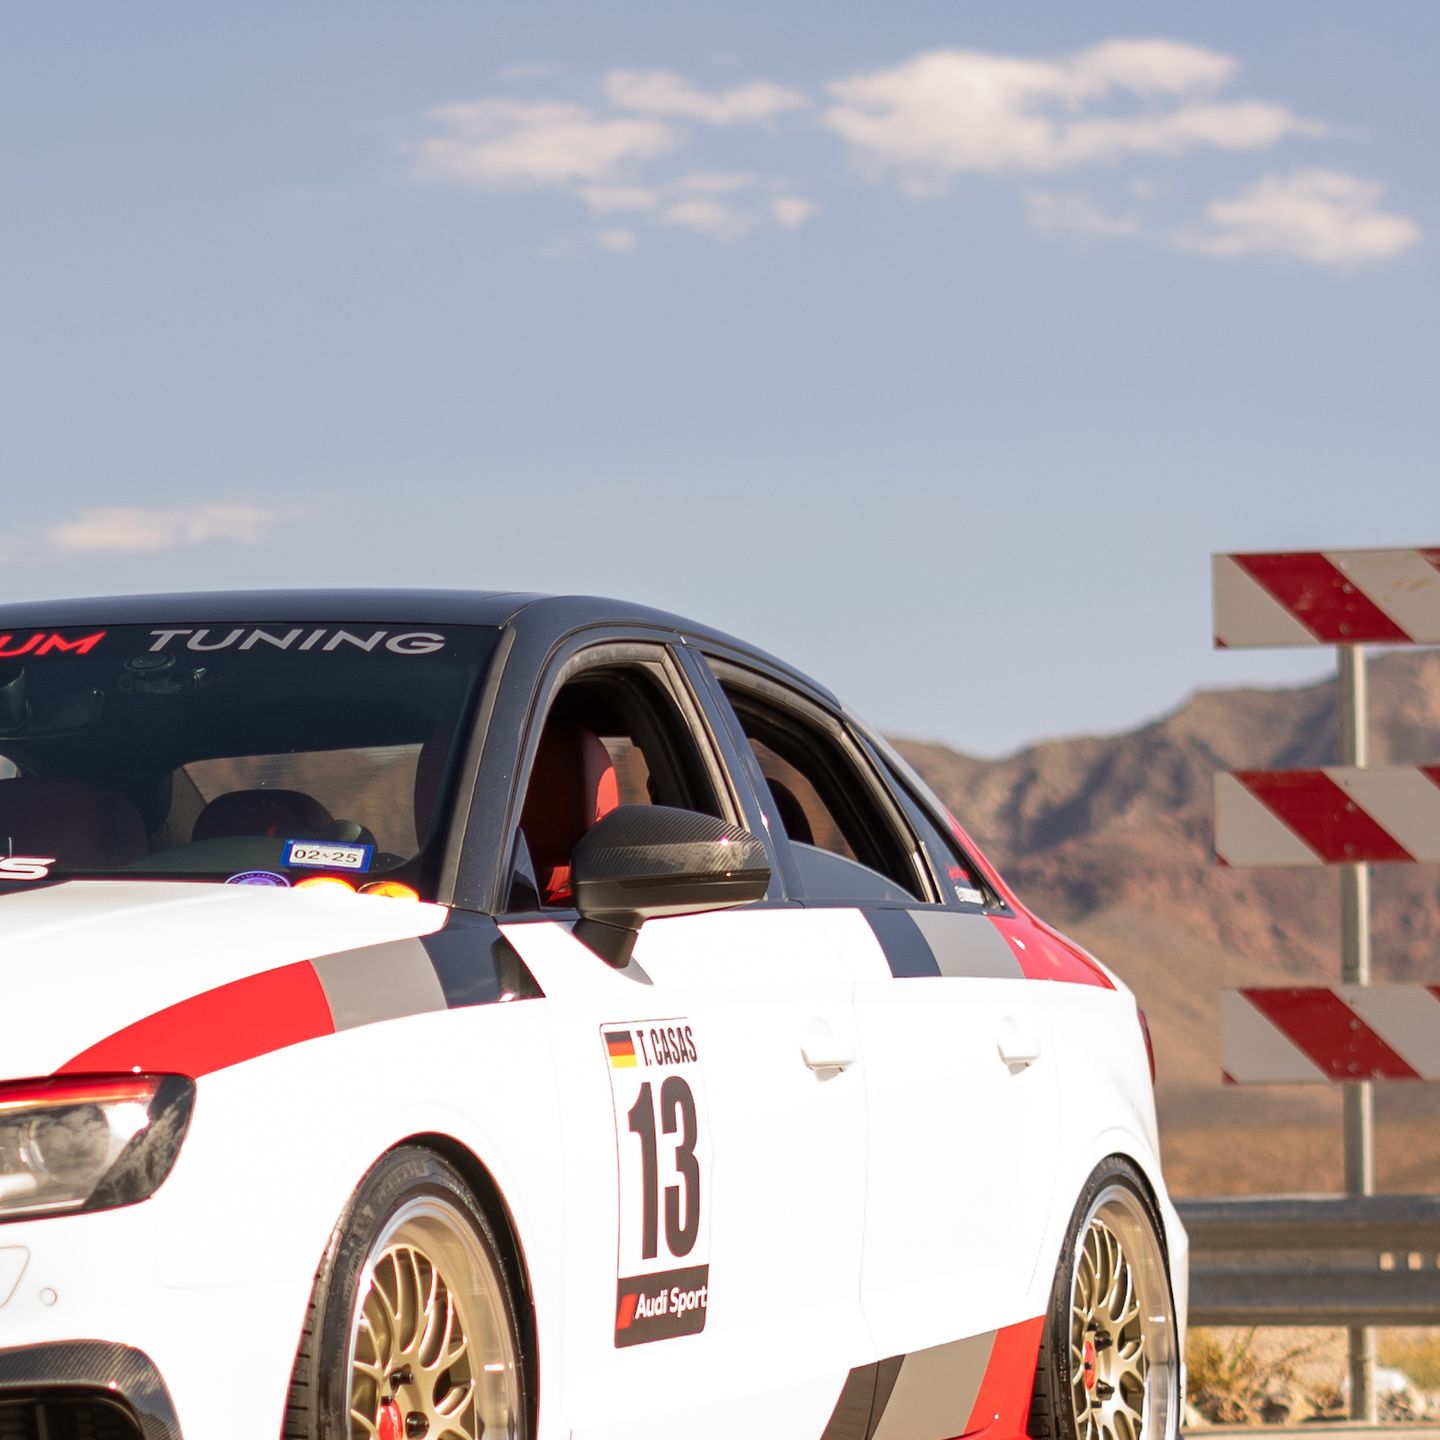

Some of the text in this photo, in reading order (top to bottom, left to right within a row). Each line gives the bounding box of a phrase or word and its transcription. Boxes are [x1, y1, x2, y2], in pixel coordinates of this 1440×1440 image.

[148, 628, 446, 655] TUNING
[636, 1024, 698, 1067] T. CASAS
[627, 1075, 701, 1260] 13
[635, 1286, 708, 1319] Audi Sport
